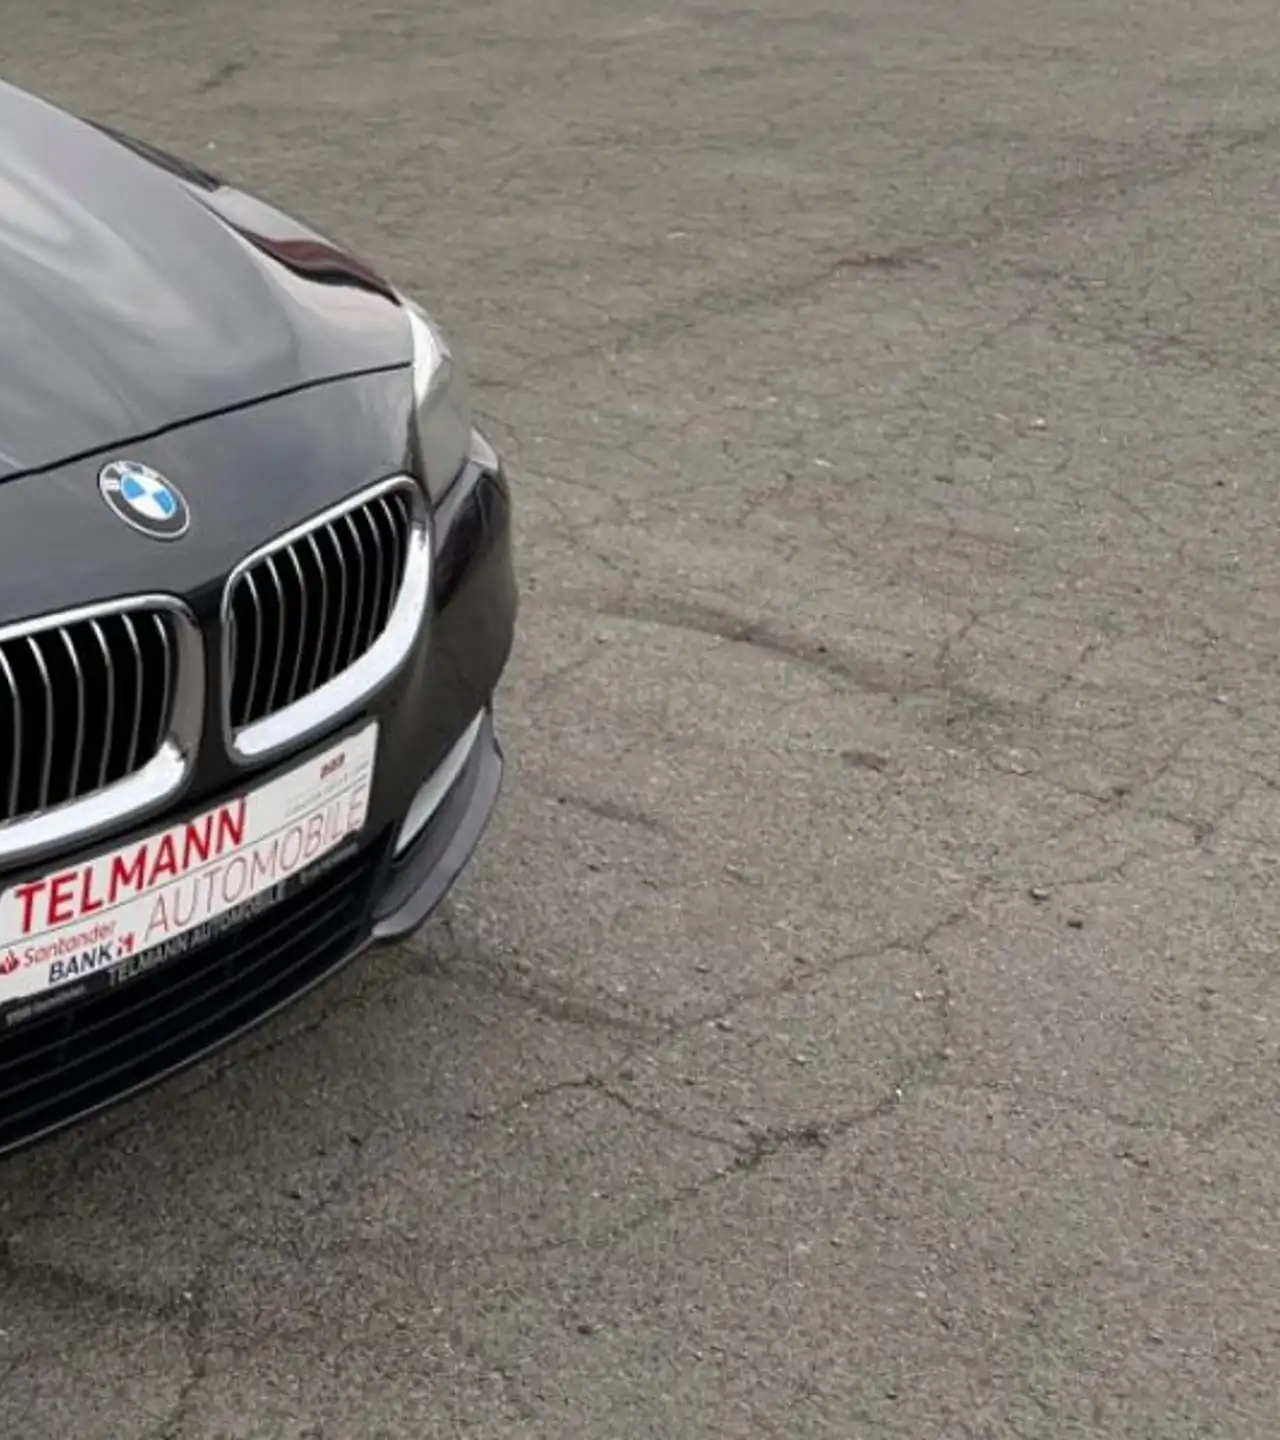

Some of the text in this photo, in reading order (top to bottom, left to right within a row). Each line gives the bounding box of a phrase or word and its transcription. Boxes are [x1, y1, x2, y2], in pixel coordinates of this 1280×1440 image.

[14, 799, 247, 935] TELMANN
[144, 782, 367, 943] AUTOMOBILE
[24, 920, 117, 967] Santander
[48, 941, 113, 984] BANK
